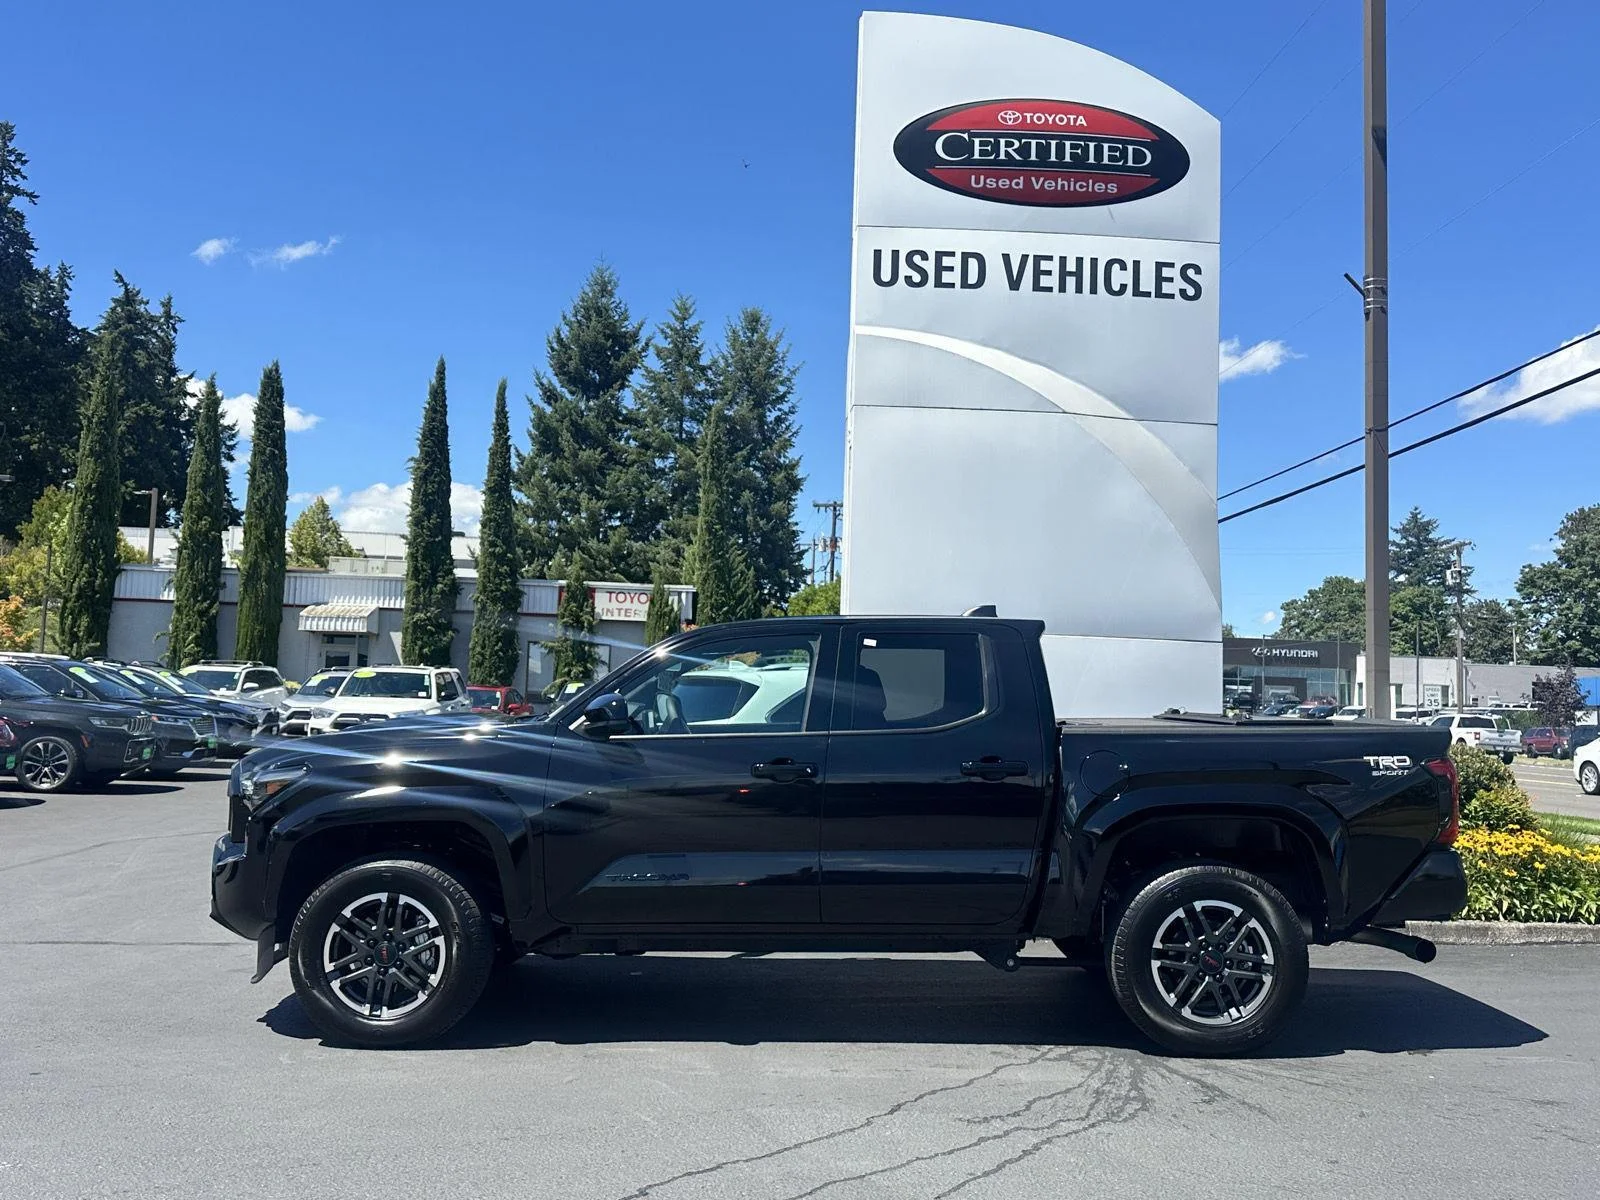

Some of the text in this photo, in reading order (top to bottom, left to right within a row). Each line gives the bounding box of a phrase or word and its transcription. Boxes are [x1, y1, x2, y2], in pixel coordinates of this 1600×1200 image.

[1023, 112, 1087, 127] TOYOTA
[934, 132, 1152, 168] CERTIFIED
[970, 174, 1118, 194] Used Vehicles
[872, 249, 1203, 301] USED VEHICLES
[606, 591, 652, 604] TOYO
[601, 608, 647, 618] INTER
[1272, 648, 1319, 658] HYUNDAI
[1427, 698, 1440, 706] 35
[1363, 755, 1411, 769] TRD
